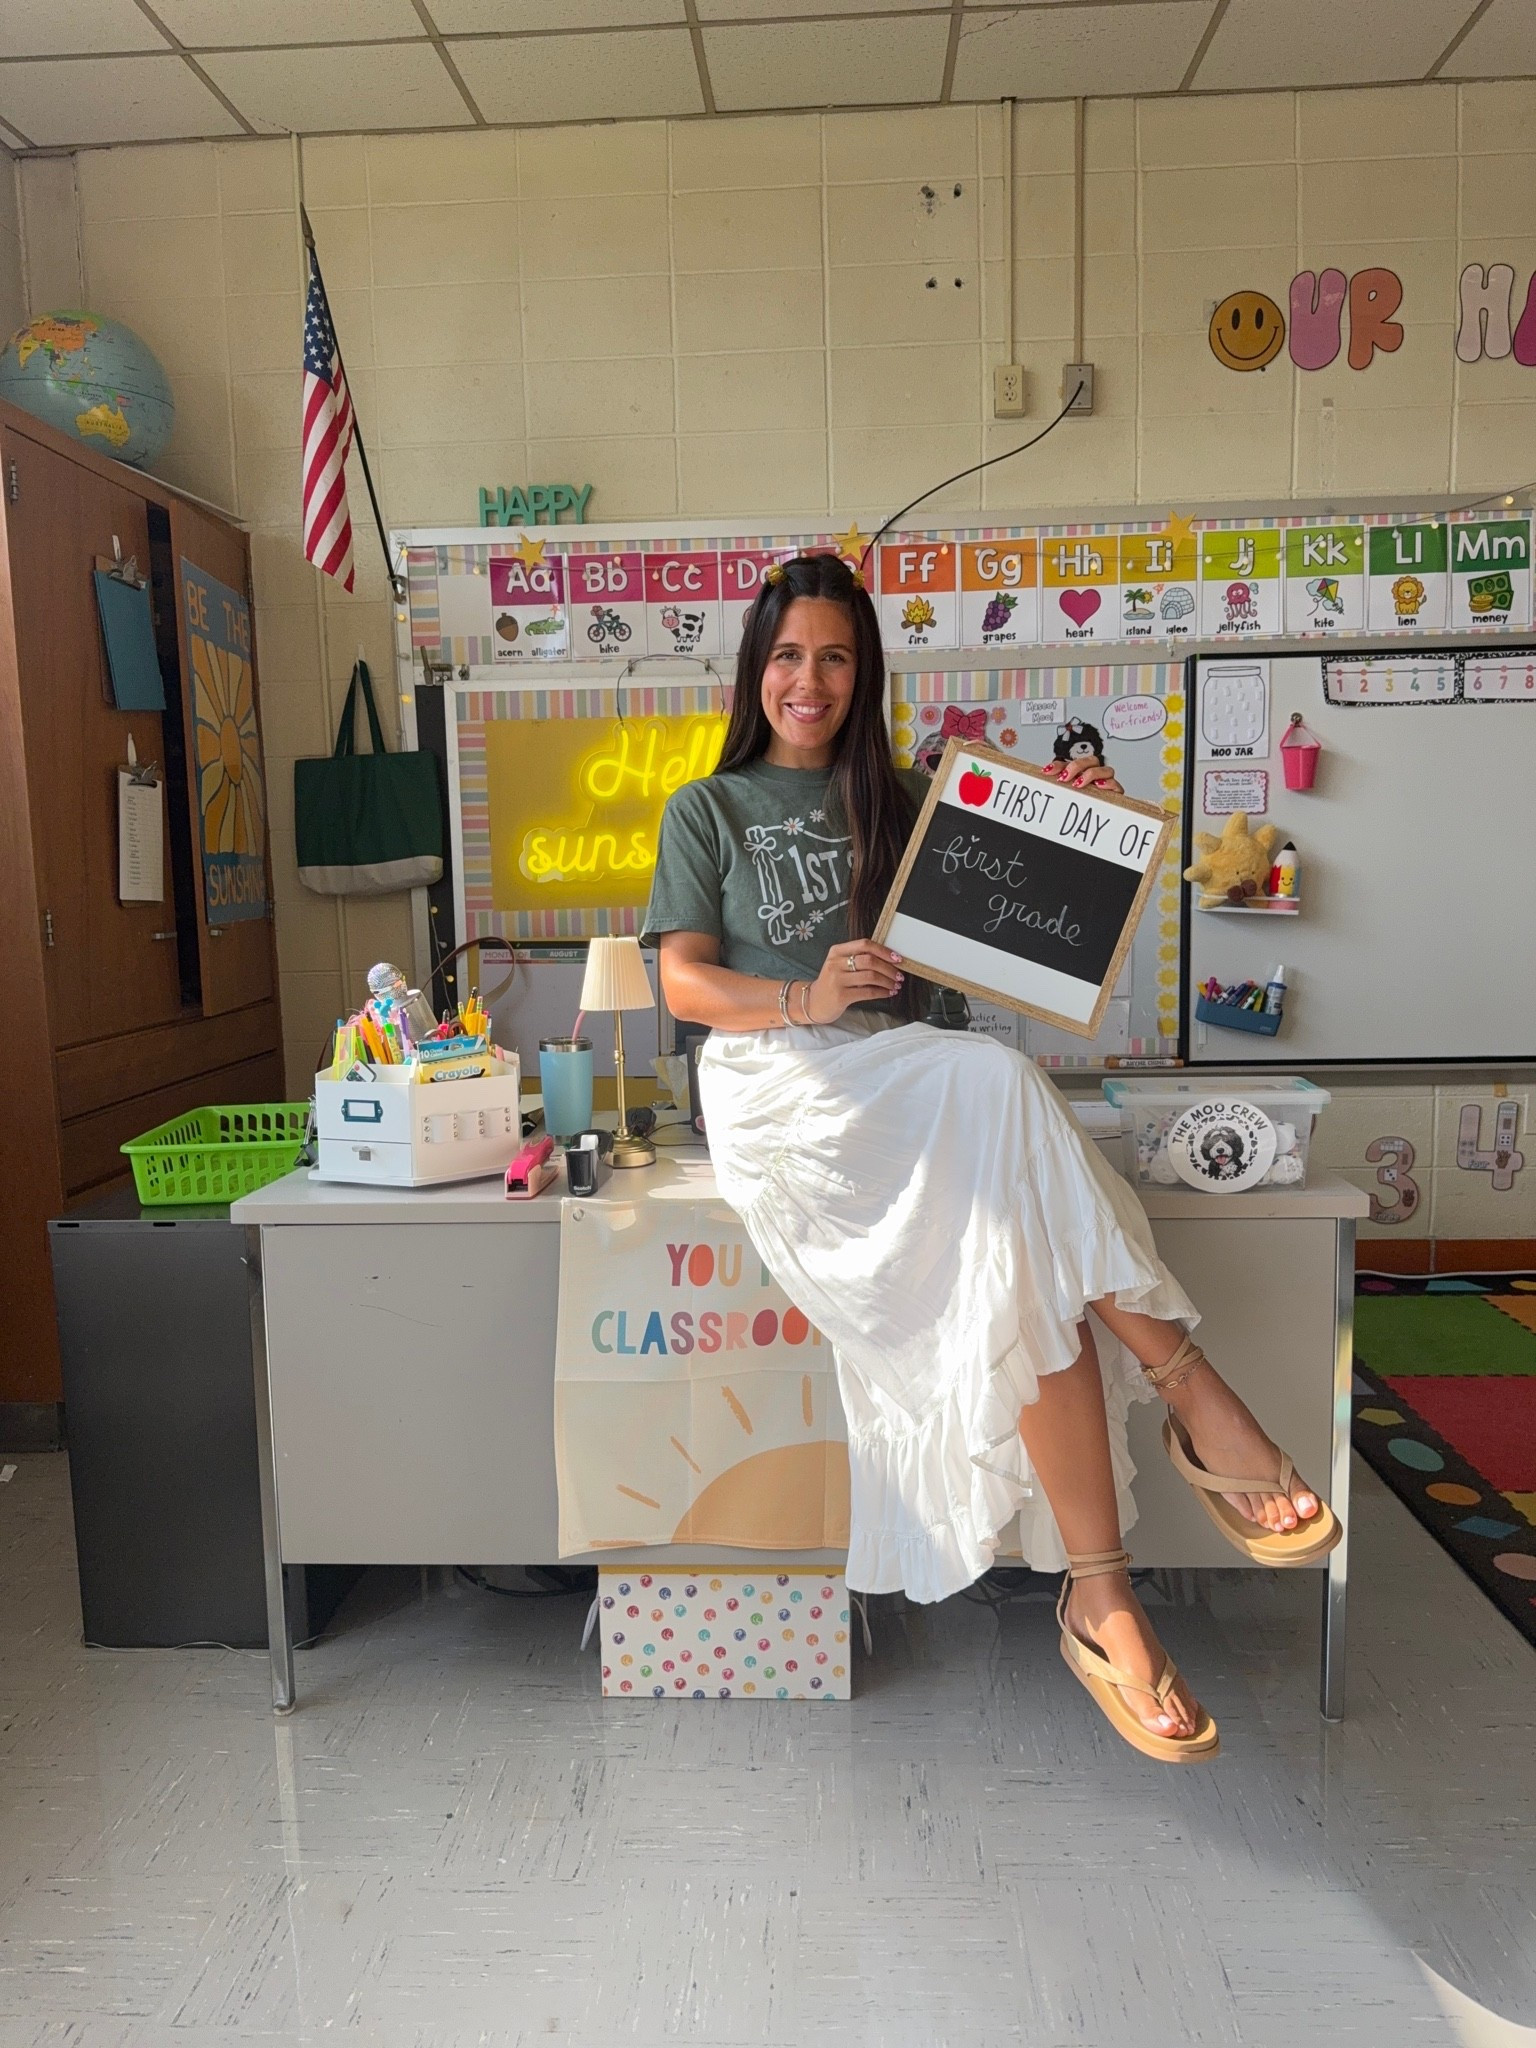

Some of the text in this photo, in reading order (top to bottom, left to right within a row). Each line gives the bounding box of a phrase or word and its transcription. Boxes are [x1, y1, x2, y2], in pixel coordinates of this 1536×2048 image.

[479, 483, 592, 527] HAPPY
[1058, 543, 1103, 577] Hh
[1145, 540, 1173, 573] Ii
[1228, 537, 1255, 577] Jj
[1303, 533, 1349, 566] Kk
[1395, 531, 1423, 565] Ll
[1456, 528, 1526, 562] Mm
[506, 562, 552, 594] Aa
[585, 561, 628, 593] Bb
[661, 560, 702, 591] Cc
[899, 551, 938, 584] Ff
[976, 548, 1022, 586] Gg
[186, 579, 250, 653] BE THE
[1125, 625, 1188, 635] island igloo
[1216, 620, 1261, 634] jellyfish
[1314, 617, 1335, 628] kite
[1398, 616, 1417, 626] lion
[1472, 613, 1508, 625] money
[599, 643, 620, 654] bike
[674, 645, 694, 653] cow
[908, 634, 929, 645] fire
[982, 631, 1016, 643] grapes
[1065, 628, 1094, 638] heart
[497, 647, 566, 657] acorn alligator
[1336, 675, 1534, 693] 1 2 3 4 5 6 7 8
[1110, 709, 1163, 730] fur-friends!
[1211, 747, 1253, 757] MOO JAR
[993, 779, 1155, 859] FIRST DAY OF
[788, 844, 841, 904] 1ST
[932, 835, 1027, 888] first
[983, 894, 1088, 946] grade
[549, 950, 578, 958] AUGUST
[979, 1022, 1012, 1035] writing
[420, 1050, 430, 1059] 10
[434, 1065, 480, 1081] Crayola
[1172, 1103, 1268, 1144] THE MOO CREW
[1457, 1102, 1524, 1192] 4
[1366, 1136, 1419, 1224] 3
[666, 1243, 743, 1287] YOU
